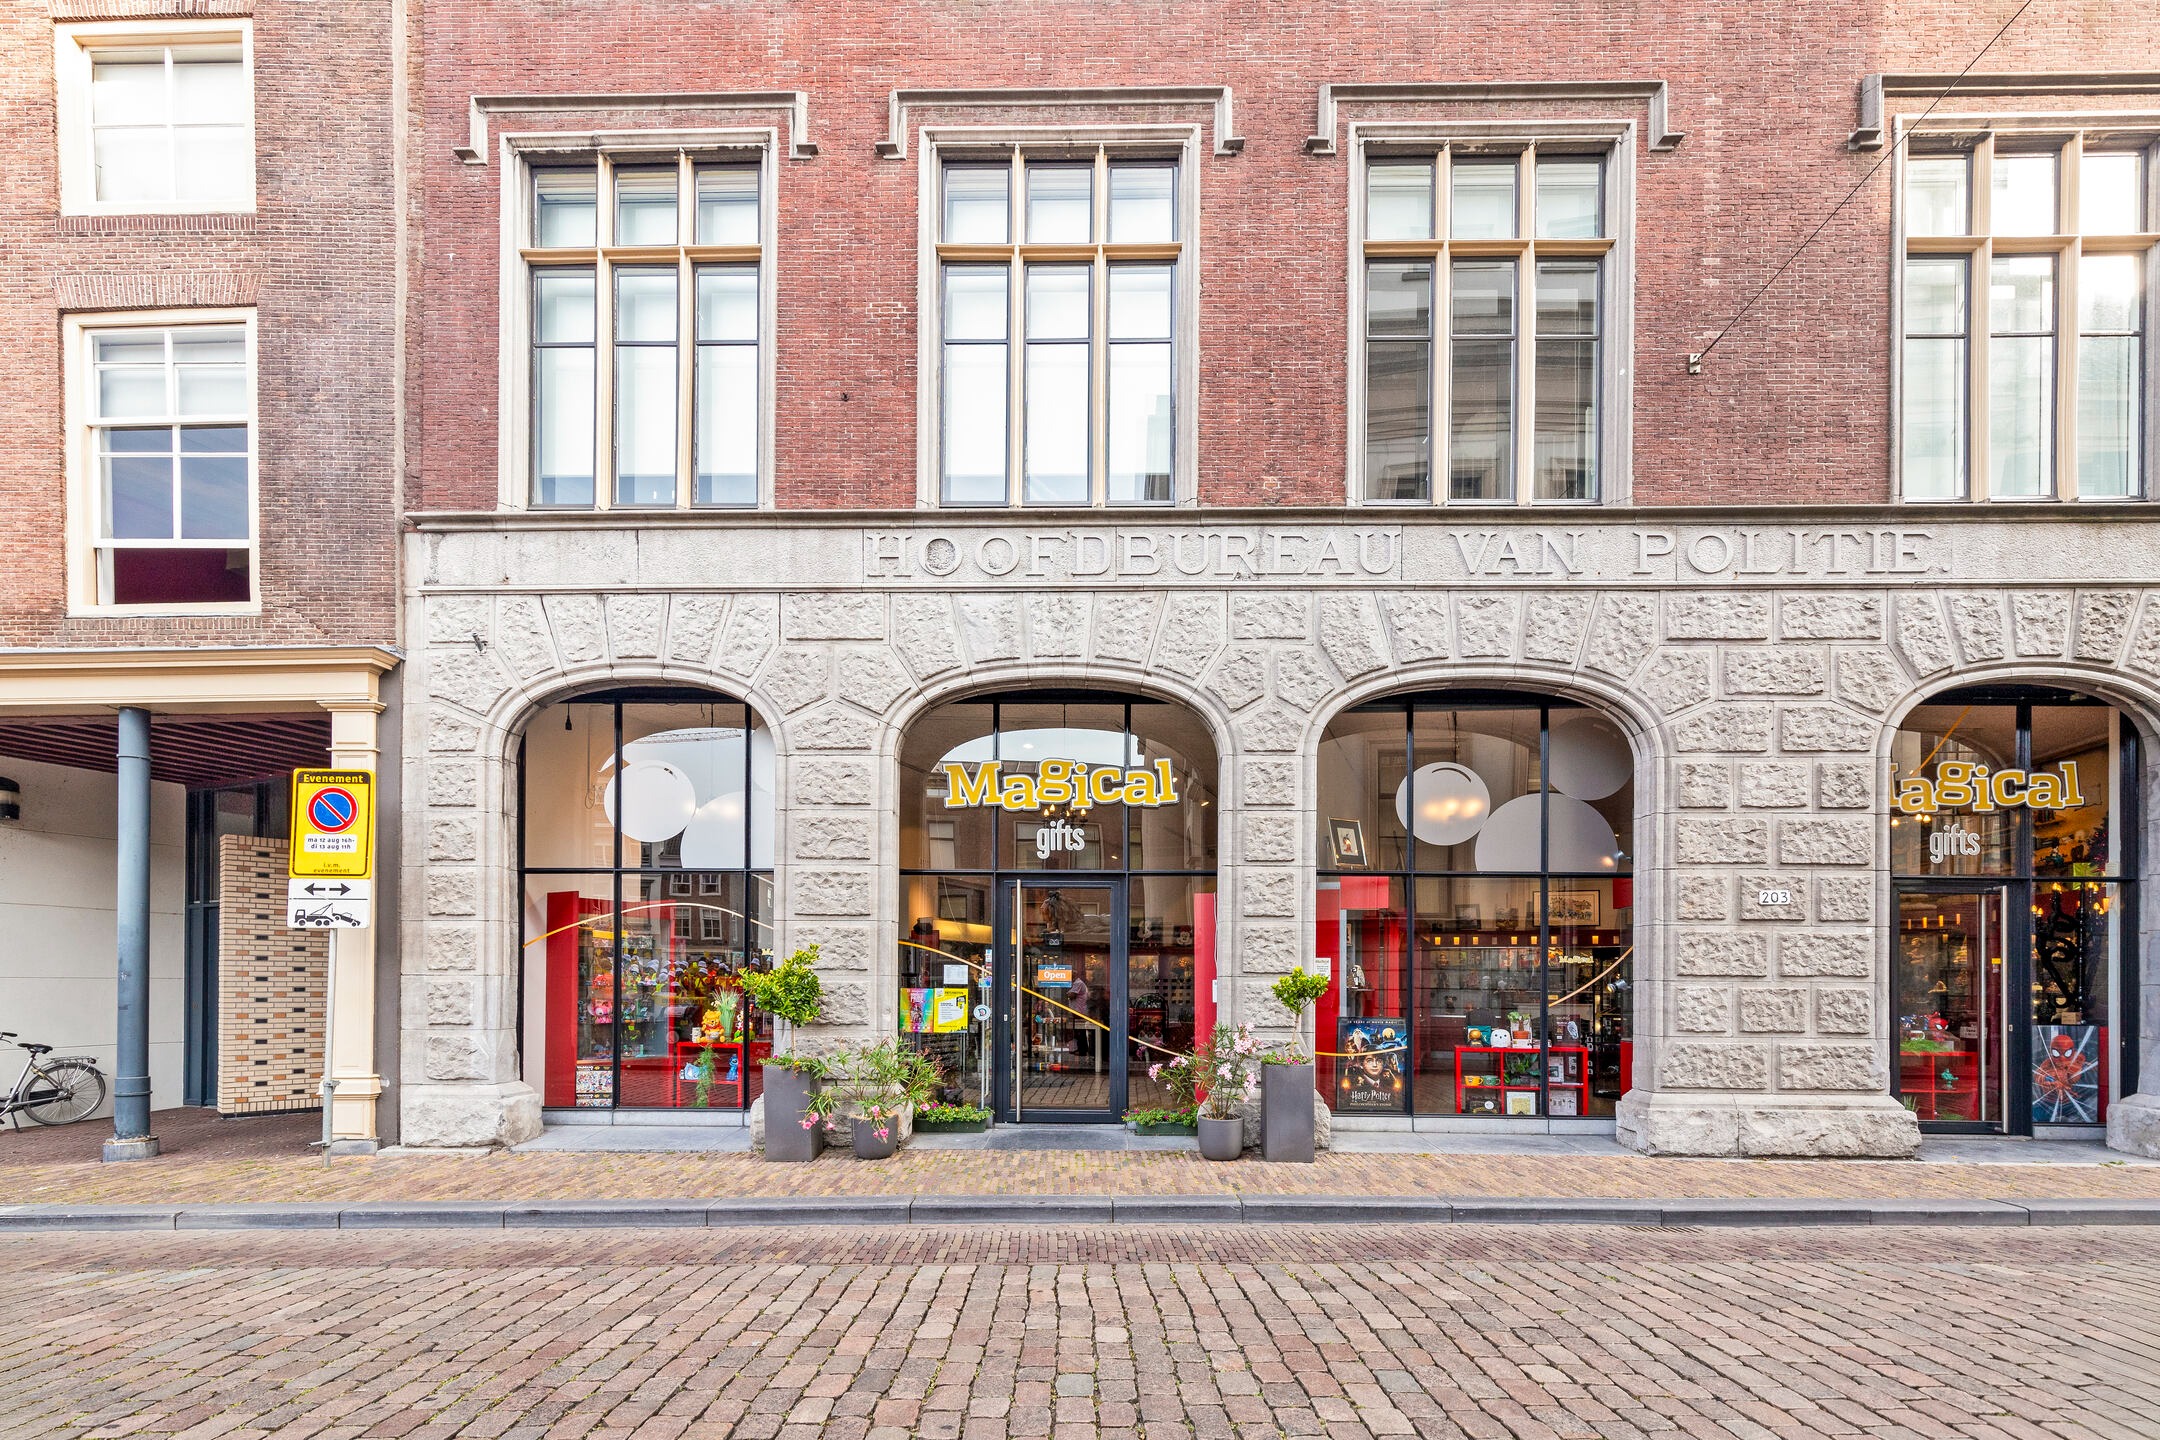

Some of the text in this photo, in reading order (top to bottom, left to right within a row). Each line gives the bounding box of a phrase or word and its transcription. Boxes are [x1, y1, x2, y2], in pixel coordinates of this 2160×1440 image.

[867, 532, 1401, 575] HOOFDBUREAU
[1449, 532, 1584, 575] VAN
[303, 773, 363, 783] Evenement
[944, 758, 1179, 811] Magical
[1890, 760, 2084, 813] agical
[1036, 819, 1085, 860] gifts
[1929, 823, 1981, 864] gifts
[1762, 891, 1788, 903] 203
[1043, 970, 1066, 980] Open
[1350, 1089, 1391, 1103] Harry Potter
